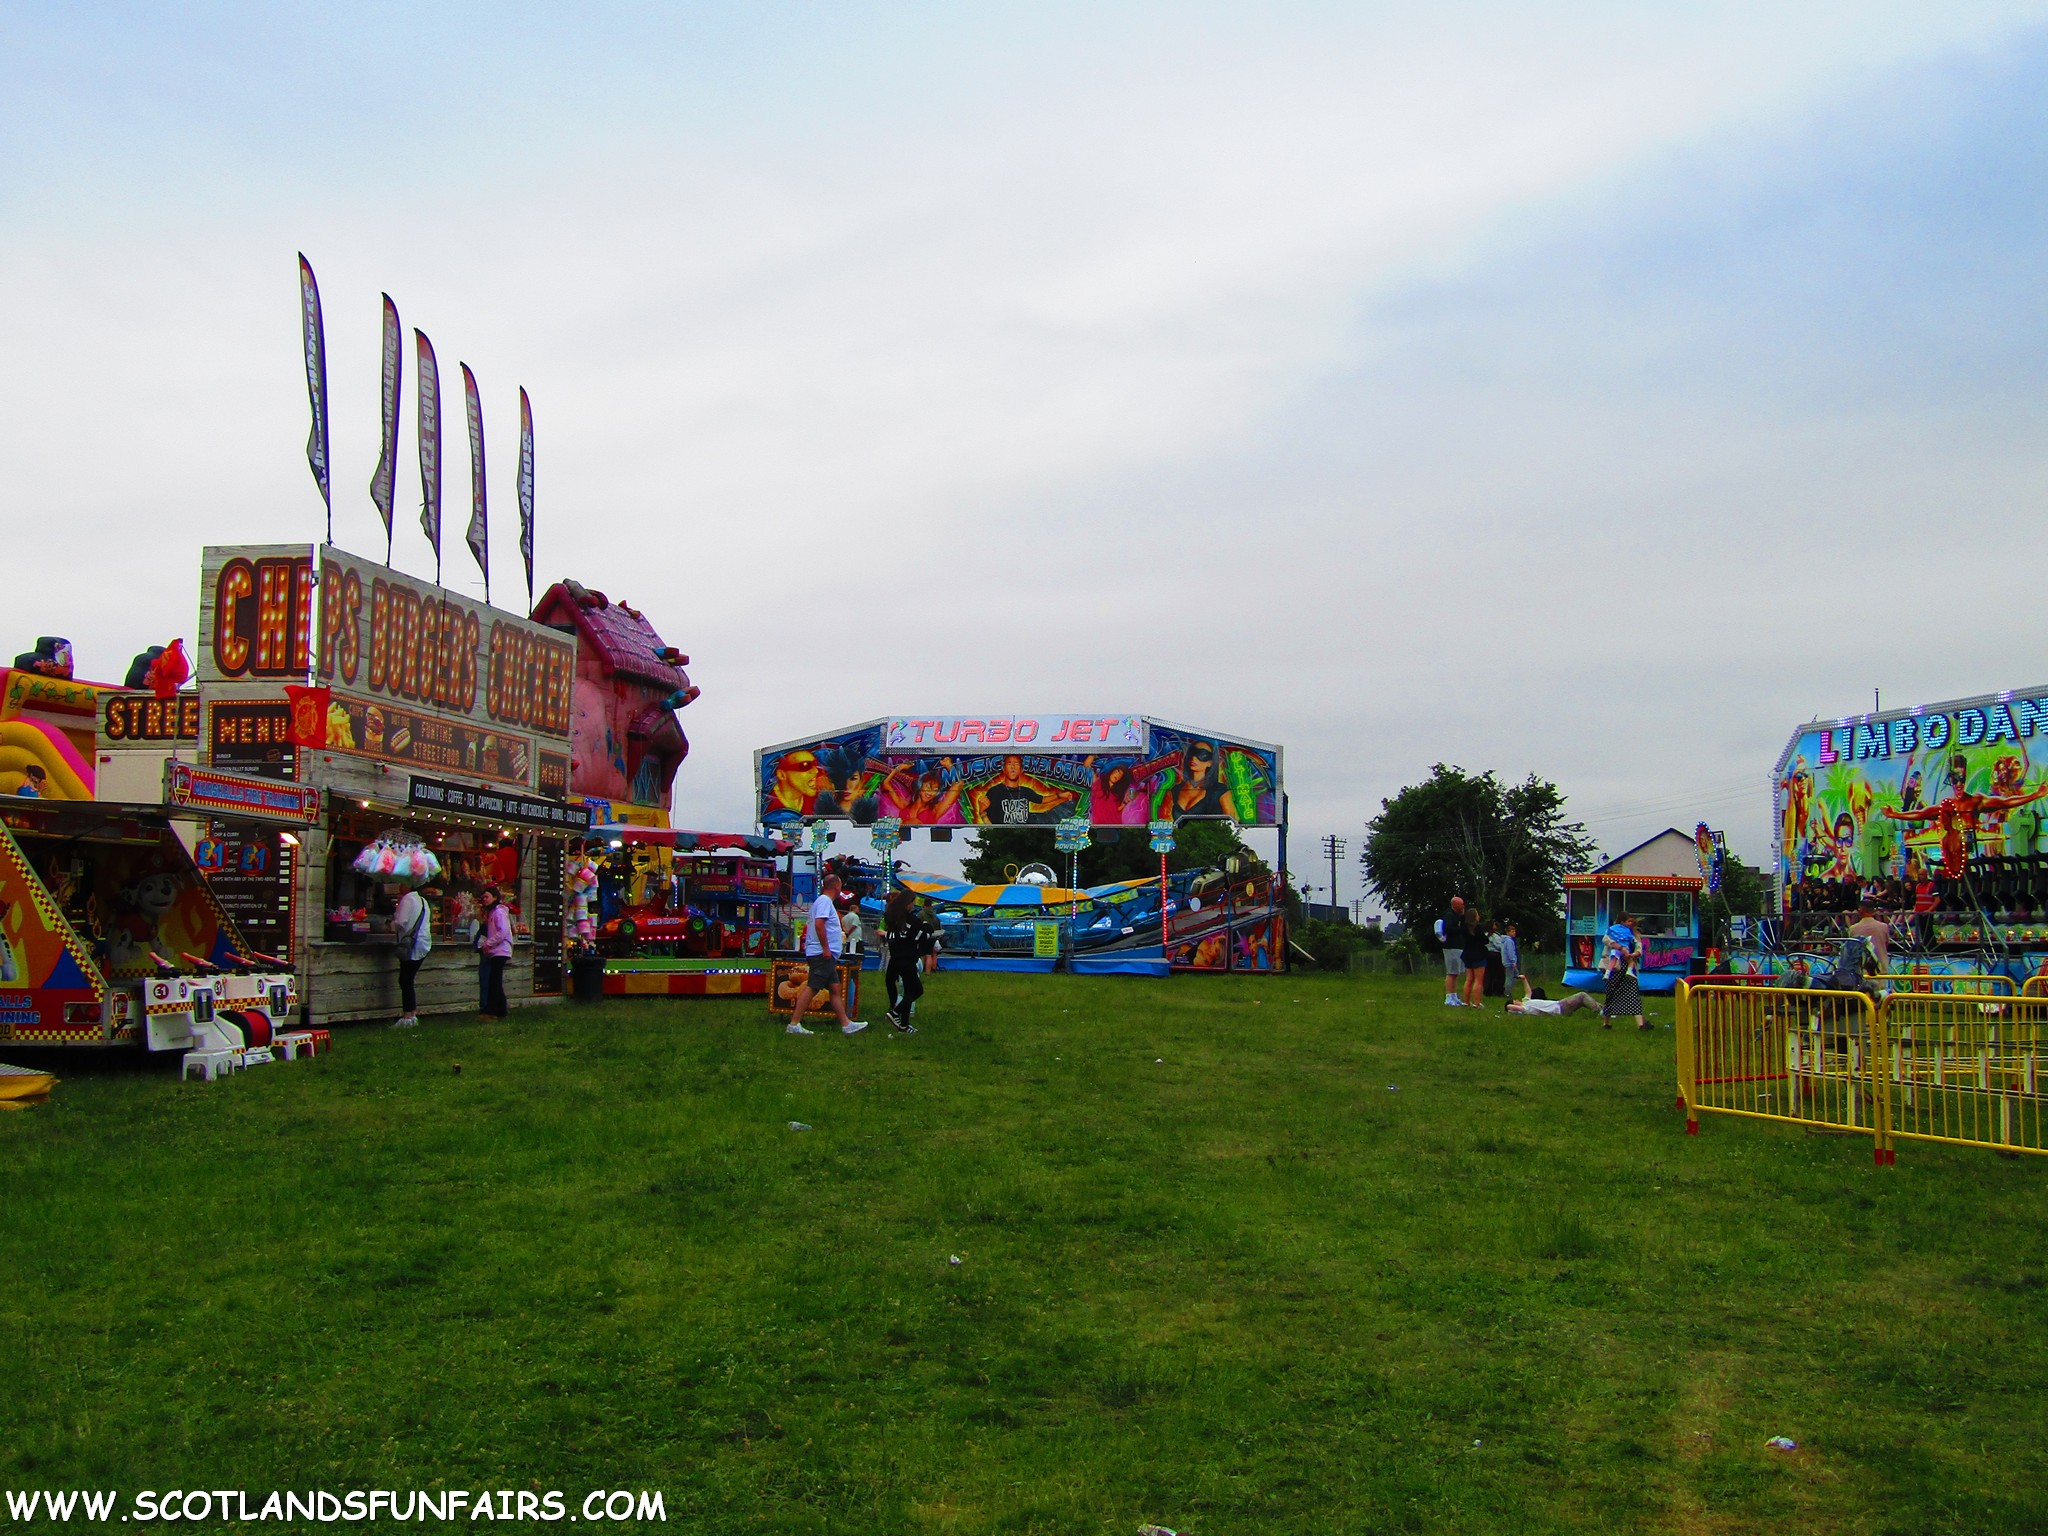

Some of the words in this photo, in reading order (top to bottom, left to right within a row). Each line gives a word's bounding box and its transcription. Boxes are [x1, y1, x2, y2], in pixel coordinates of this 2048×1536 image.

[370, 579, 478, 712] BURGERS
[488, 619, 573, 734] CHICKEN
[219, 716, 287, 744] MENU
[909, 719, 1039, 743] TURBO
[1051, 719, 1119, 742] JET
[413, 741, 443, 764] STREET
[541, 763, 565, 786] MENU
[941, 754, 1004, 788] MUSIC
[1022, 755, 1095, 788] EXPLOSION
[193, 778, 244, 802] MARSHALLS
[245, 786, 262, 804] FIRE
[264, 791, 300, 810] TRAINING
[1230, 750, 1255, 819] ULTIMATE
[414, 783, 428, 798] COLD
[428, 785, 444, 802] DRINKS
[447, 788, 464, 804] COFFEE
[466, 793, 475, 807] TEA
[478, 795, 503, 812] CAPPUCCINO
[506, 800, 518, 814] LATTE
[520, 802, 528, 816] HOT
[528, 804, 549, 818] CHOCOLATE
[566, 810, 576, 823] COLD
[576, 812, 588, 825] WATER
[781, 822, 804, 830] TURBO
[198, 841, 224, 867] £1
[241, 846, 266, 870] £1
[1154, 844, 1170, 852] JET
[154, 986, 166, 996] £1
